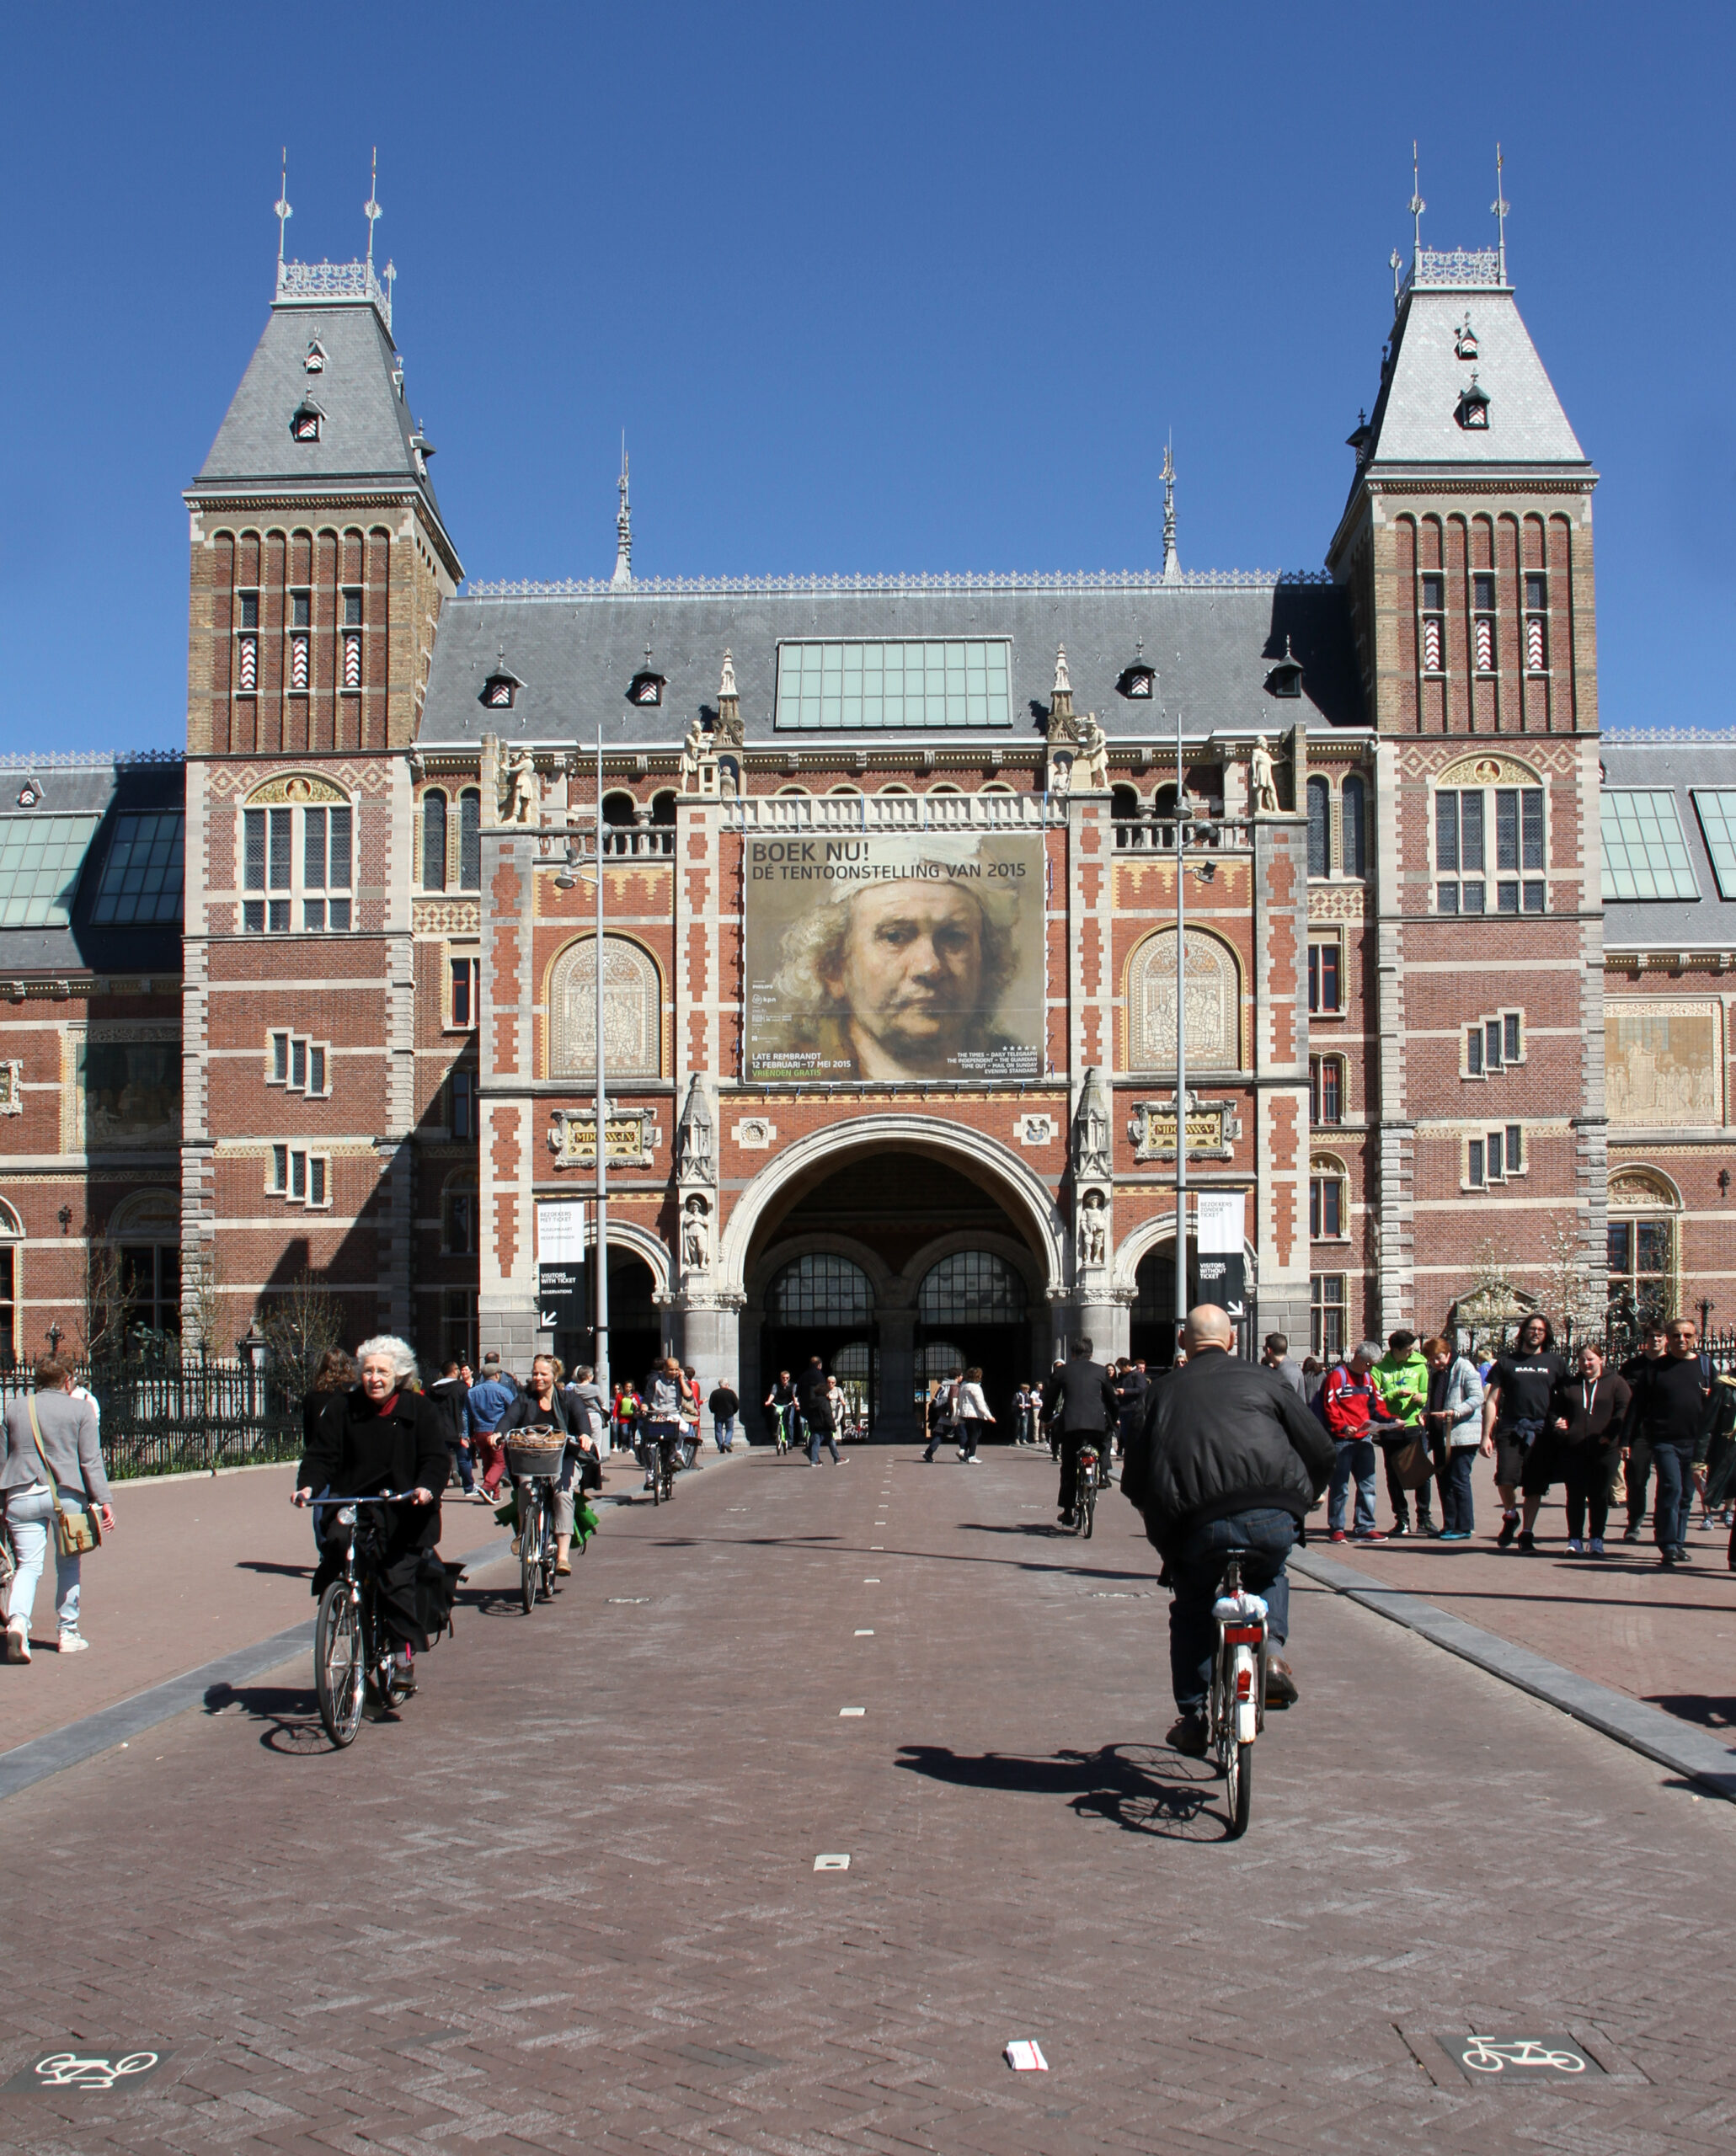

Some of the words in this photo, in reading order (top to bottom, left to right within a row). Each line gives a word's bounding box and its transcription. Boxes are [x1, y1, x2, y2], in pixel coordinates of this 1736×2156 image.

[752, 842, 816, 862] BOEK
[826, 842, 869, 862] NU!
[752, 863, 774, 880] DÉ
[779, 864, 939, 880] TENTOONSTELLING
[946, 864, 980, 878] VAN
[987, 863, 1026, 878] 2015
